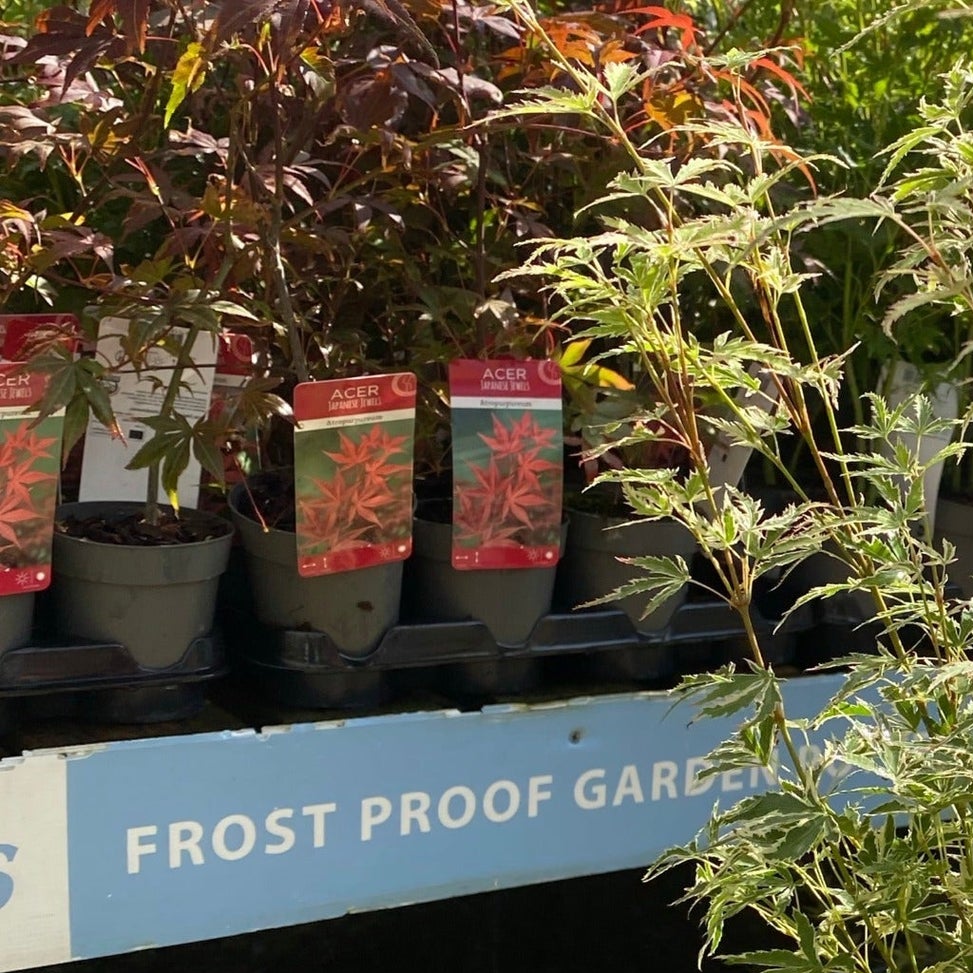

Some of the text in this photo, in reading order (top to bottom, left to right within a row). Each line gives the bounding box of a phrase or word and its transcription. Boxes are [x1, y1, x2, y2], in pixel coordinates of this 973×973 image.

[482, 368, 527, 380] ACER
[330, 385, 380, 401] ACER
[127, 803, 336, 874] FROST
[361, 775, 553, 841] PROOF
